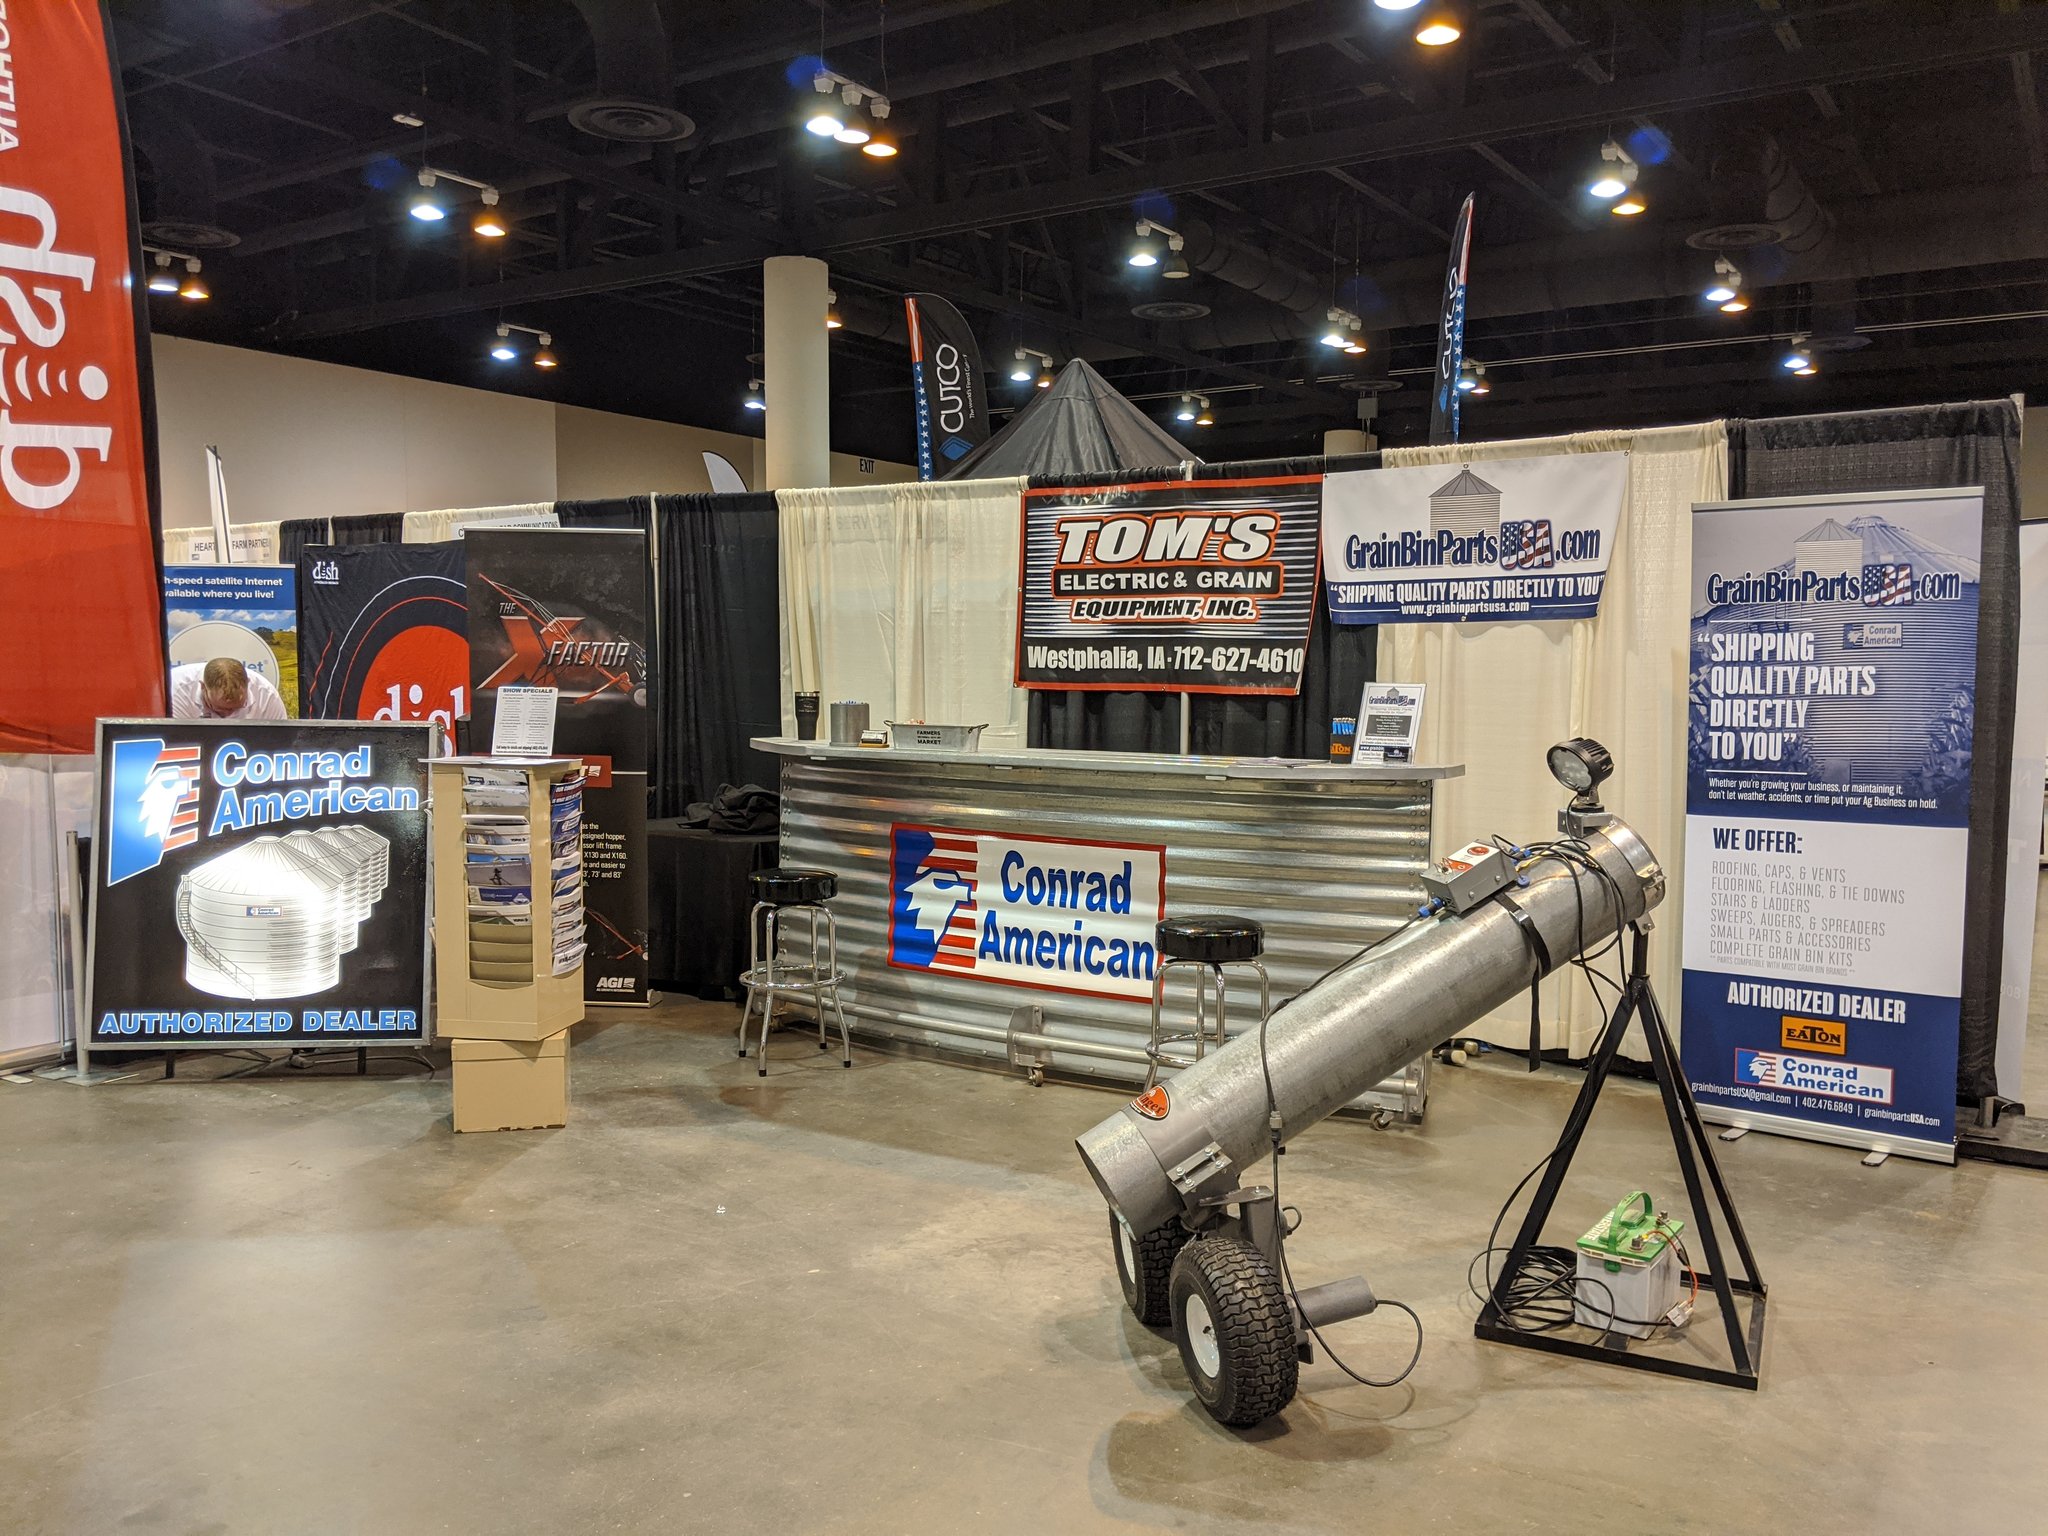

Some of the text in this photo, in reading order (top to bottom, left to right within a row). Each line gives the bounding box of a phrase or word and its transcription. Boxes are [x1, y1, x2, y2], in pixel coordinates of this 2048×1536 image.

[936, 343, 964, 433] CUTCO
[859, 458, 875, 474] EXIT
[1057, 514, 1276, 564] TOM'S
[164, 577, 283, 586] h-speed satellite Internet
[312, 561, 339, 580] dish
[1060, 571, 1273, 590] ELECTRIC & GRAIN
[165, 590, 274, 600] vailable where you live!
[1396, 582, 1447, 603] QUALITY
[1449, 580, 1490, 600] PARTS
[1492, 578, 1557, 599] DIRECTLY
[1557, 577, 1574, 597] TO
[499, 602, 516, 614] THE
[1073, 598, 1255, 621] EQUIPMENT, INC.
[1401, 602, 1530, 616] www.grainbinpartsusa.com
[1864, 636, 1901, 645] American
[1869, 625, 1897, 635] Conrad
[546, 640, 630, 667] FACTOR
[1027, 646, 1143, 672] Westphalia,
[1711, 666, 1876, 698] QUALITY PARTS
[1709, 699, 1809, 729] DIRECTLY
[1709, 732, 1735, 760] TO
[212, 742, 371, 787] Conrad
[1709, 778, 1737, 788] Whether
[1738, 779, 1759, 790] you're
[1761, 781, 1789, 791] growing
[1790, 783, 1806, 791] your
[1842, 784, 1850, 792] or
[1852, 783, 1894, 795] maintaining
[208, 779, 419, 836] American
[1709, 790, 1726, 800] don't
[1726, 790, 1736, 800] let
[1805, 795, 1812, 803] or
[1814, 794, 1830, 804] time
[1831, 796, 1844, 806] put
[1845, 798, 1862, 807] your
[1863, 797, 1873, 808] Ag
[1874, 797, 1906, 808] Business
[1908, 800, 1918, 808] on
[1919, 798, 1938, 809] hold.
[582, 832, 605, 840] esigned
[590, 822, 599, 830] the
[605, 842, 622, 850] frame
[1713, 827, 1803, 854] WE OFFER:
[601, 861, 618, 869] easier
[1712, 860, 1846, 883] ROOFING, CAPS, & VENTS
[1000, 850, 1132, 915] Conrad
[1711, 876, 1905, 904] FLOORING, FLASHING, & TIE DOWNS
[1711, 893, 1810, 914] STAIRS & LADDERS
[1711, 908, 1886, 937] SWEEPS, AUGERS, & SPREADERS
[979, 910, 1155, 981] American
[1711, 924, 1871, 952] SMALL PARTS & ACCESSORIES
[1710, 940, 1853, 967] COMPLETE GRAIN BIN KITS
[1717, 956, 1848, 977] PARTS COMPATIBLE WITH MOST GRAIN BIN BRANDS
[596, 977, 624, 988] AGI
[1727, 981, 1906, 1024] AUTHORIZED DEALER
[98, 1010, 417, 1034] AUTHORIZED DEALER
[1782, 1057, 1858, 1081] Conrad
[1782, 1072, 1884, 1099] American
[1691, 1082, 1940, 1127] grainbinpartsUSA@gmail.com 402.476.6849 grainbinpartsUSA.com
